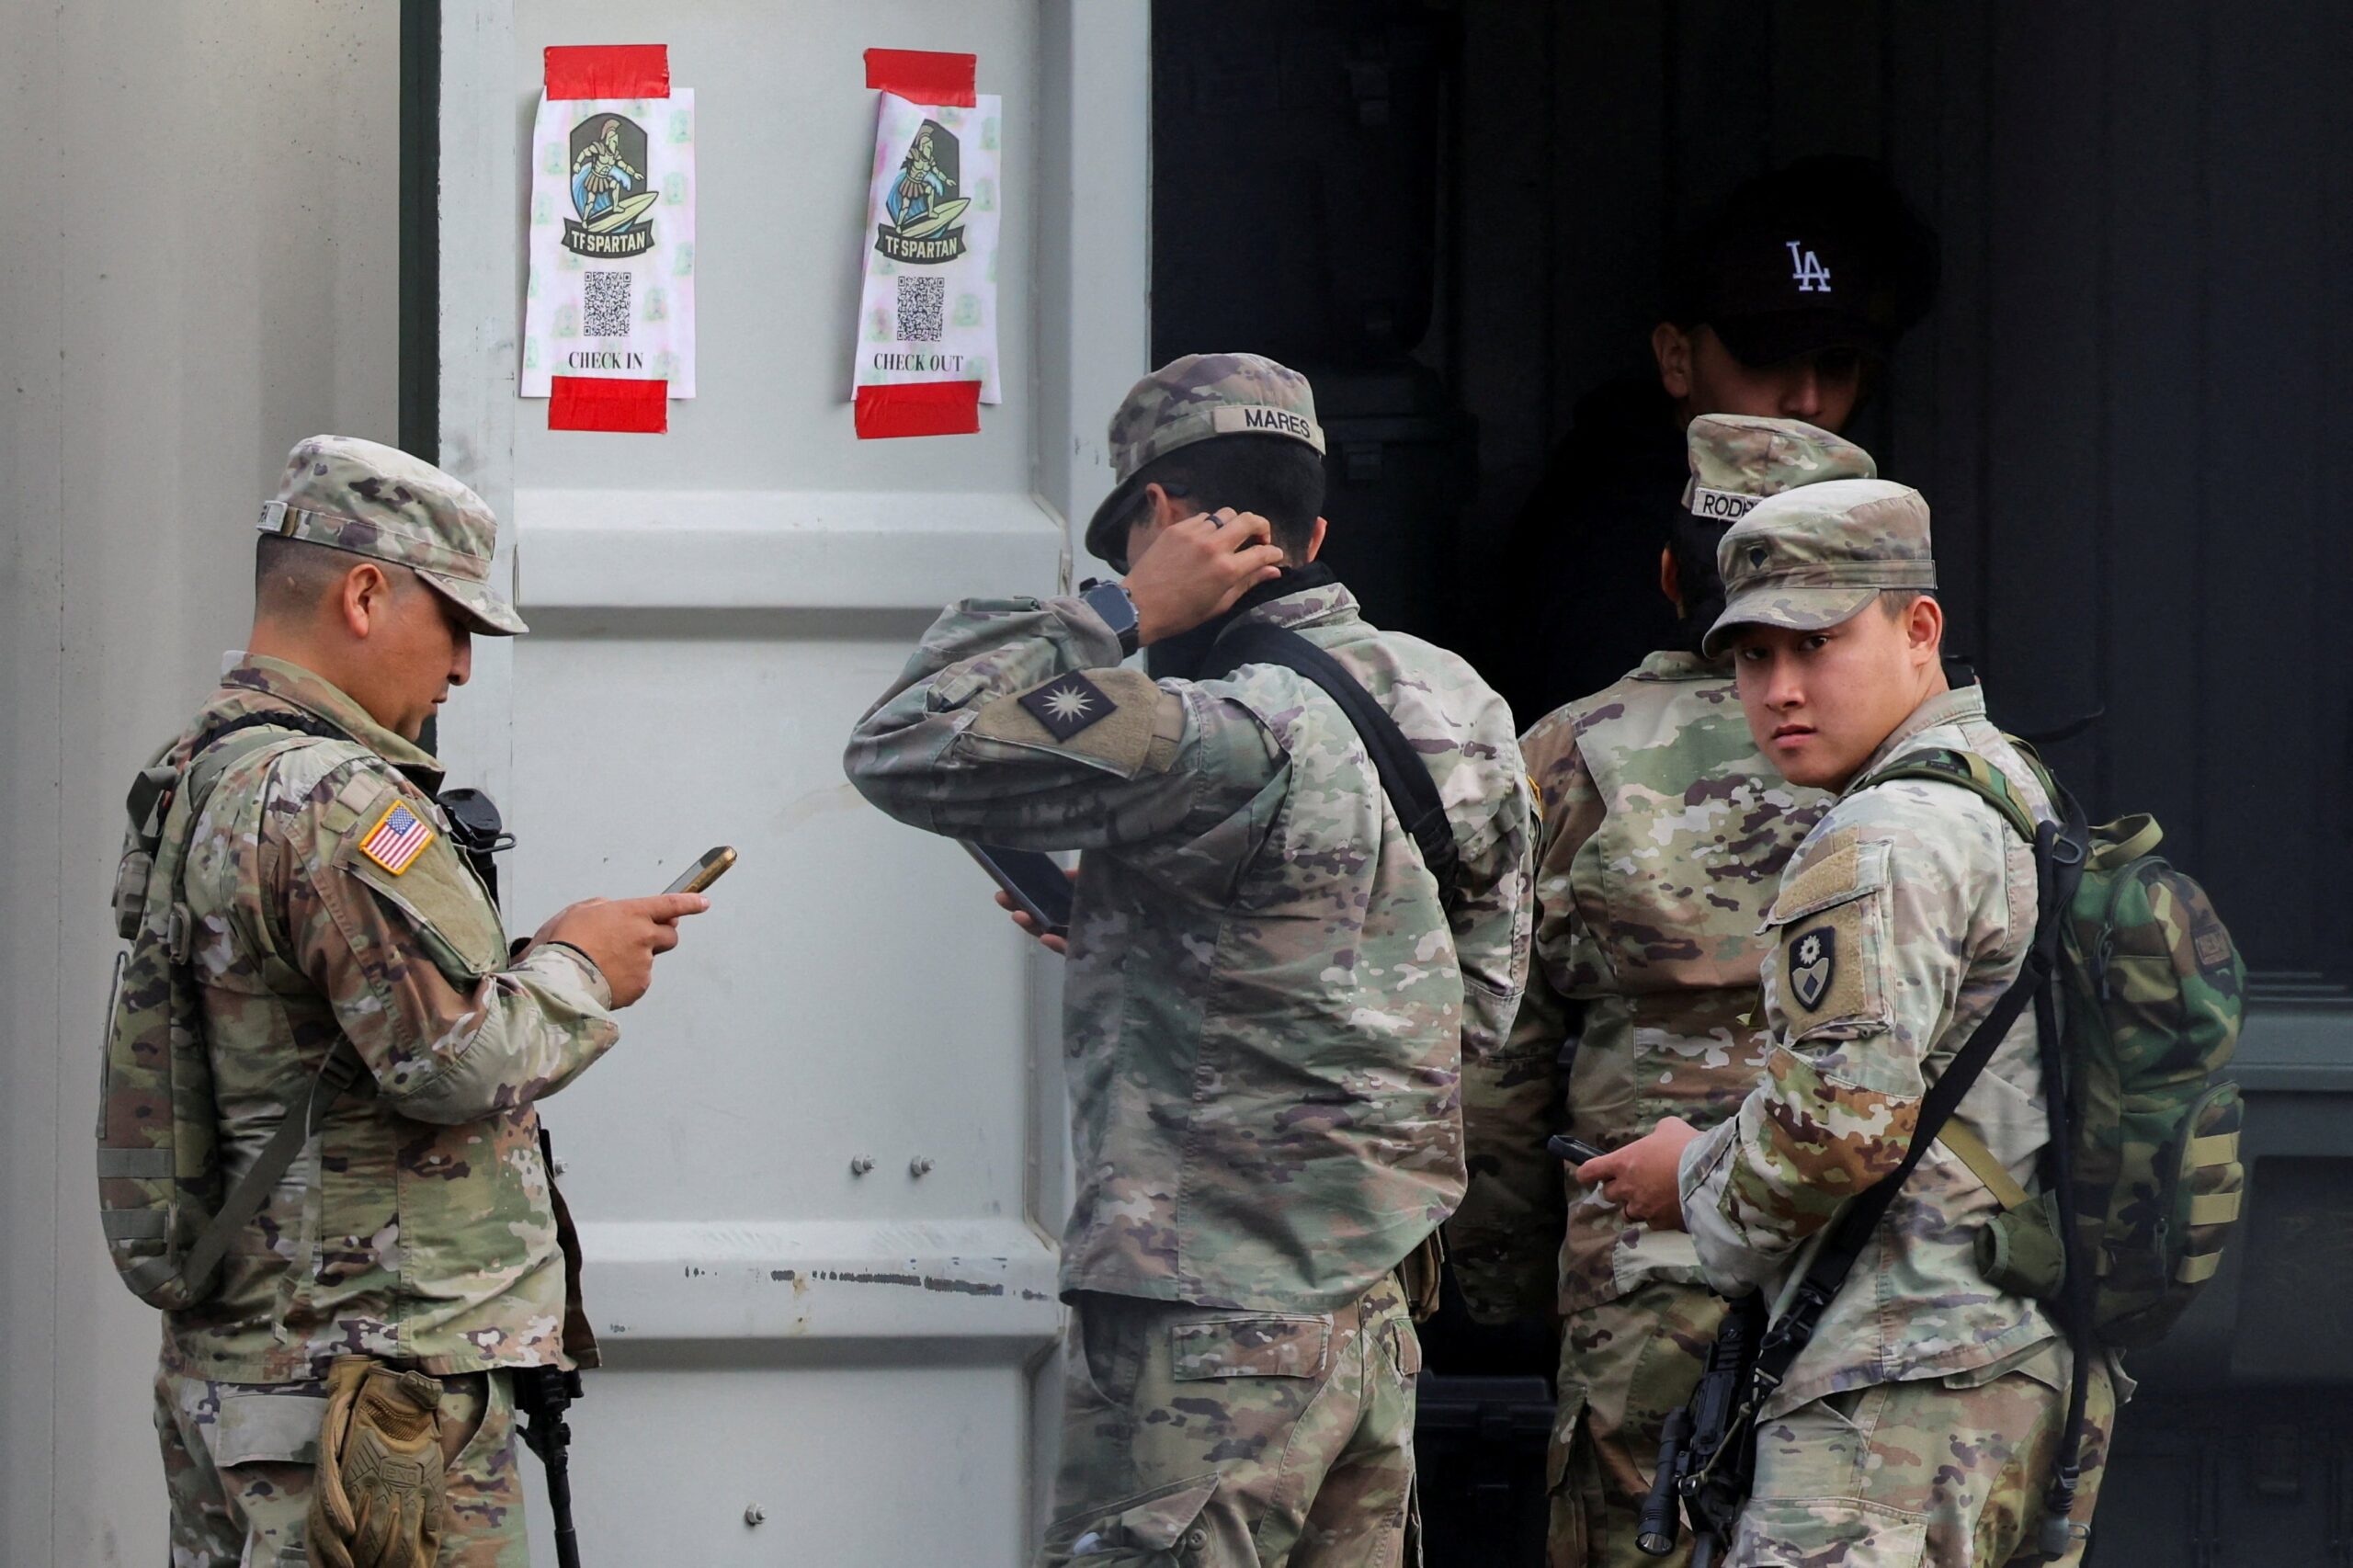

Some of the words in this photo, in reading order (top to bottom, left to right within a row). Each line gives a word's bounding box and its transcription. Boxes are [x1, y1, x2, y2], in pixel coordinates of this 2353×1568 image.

[571, 230, 586, 250] TF
[586, 231, 645, 253] SPARTAN
[885, 234, 900, 255] TF
[901, 236, 958, 258] SPARTAN
[1786, 241, 1831, 291] LA
[568, 351, 621, 369] CHECK
[626, 352, 643, 369] IN
[873, 352, 925, 371] CHECK
[930, 354, 964, 372] OUT
[1245, 409, 1311, 438] MARES
